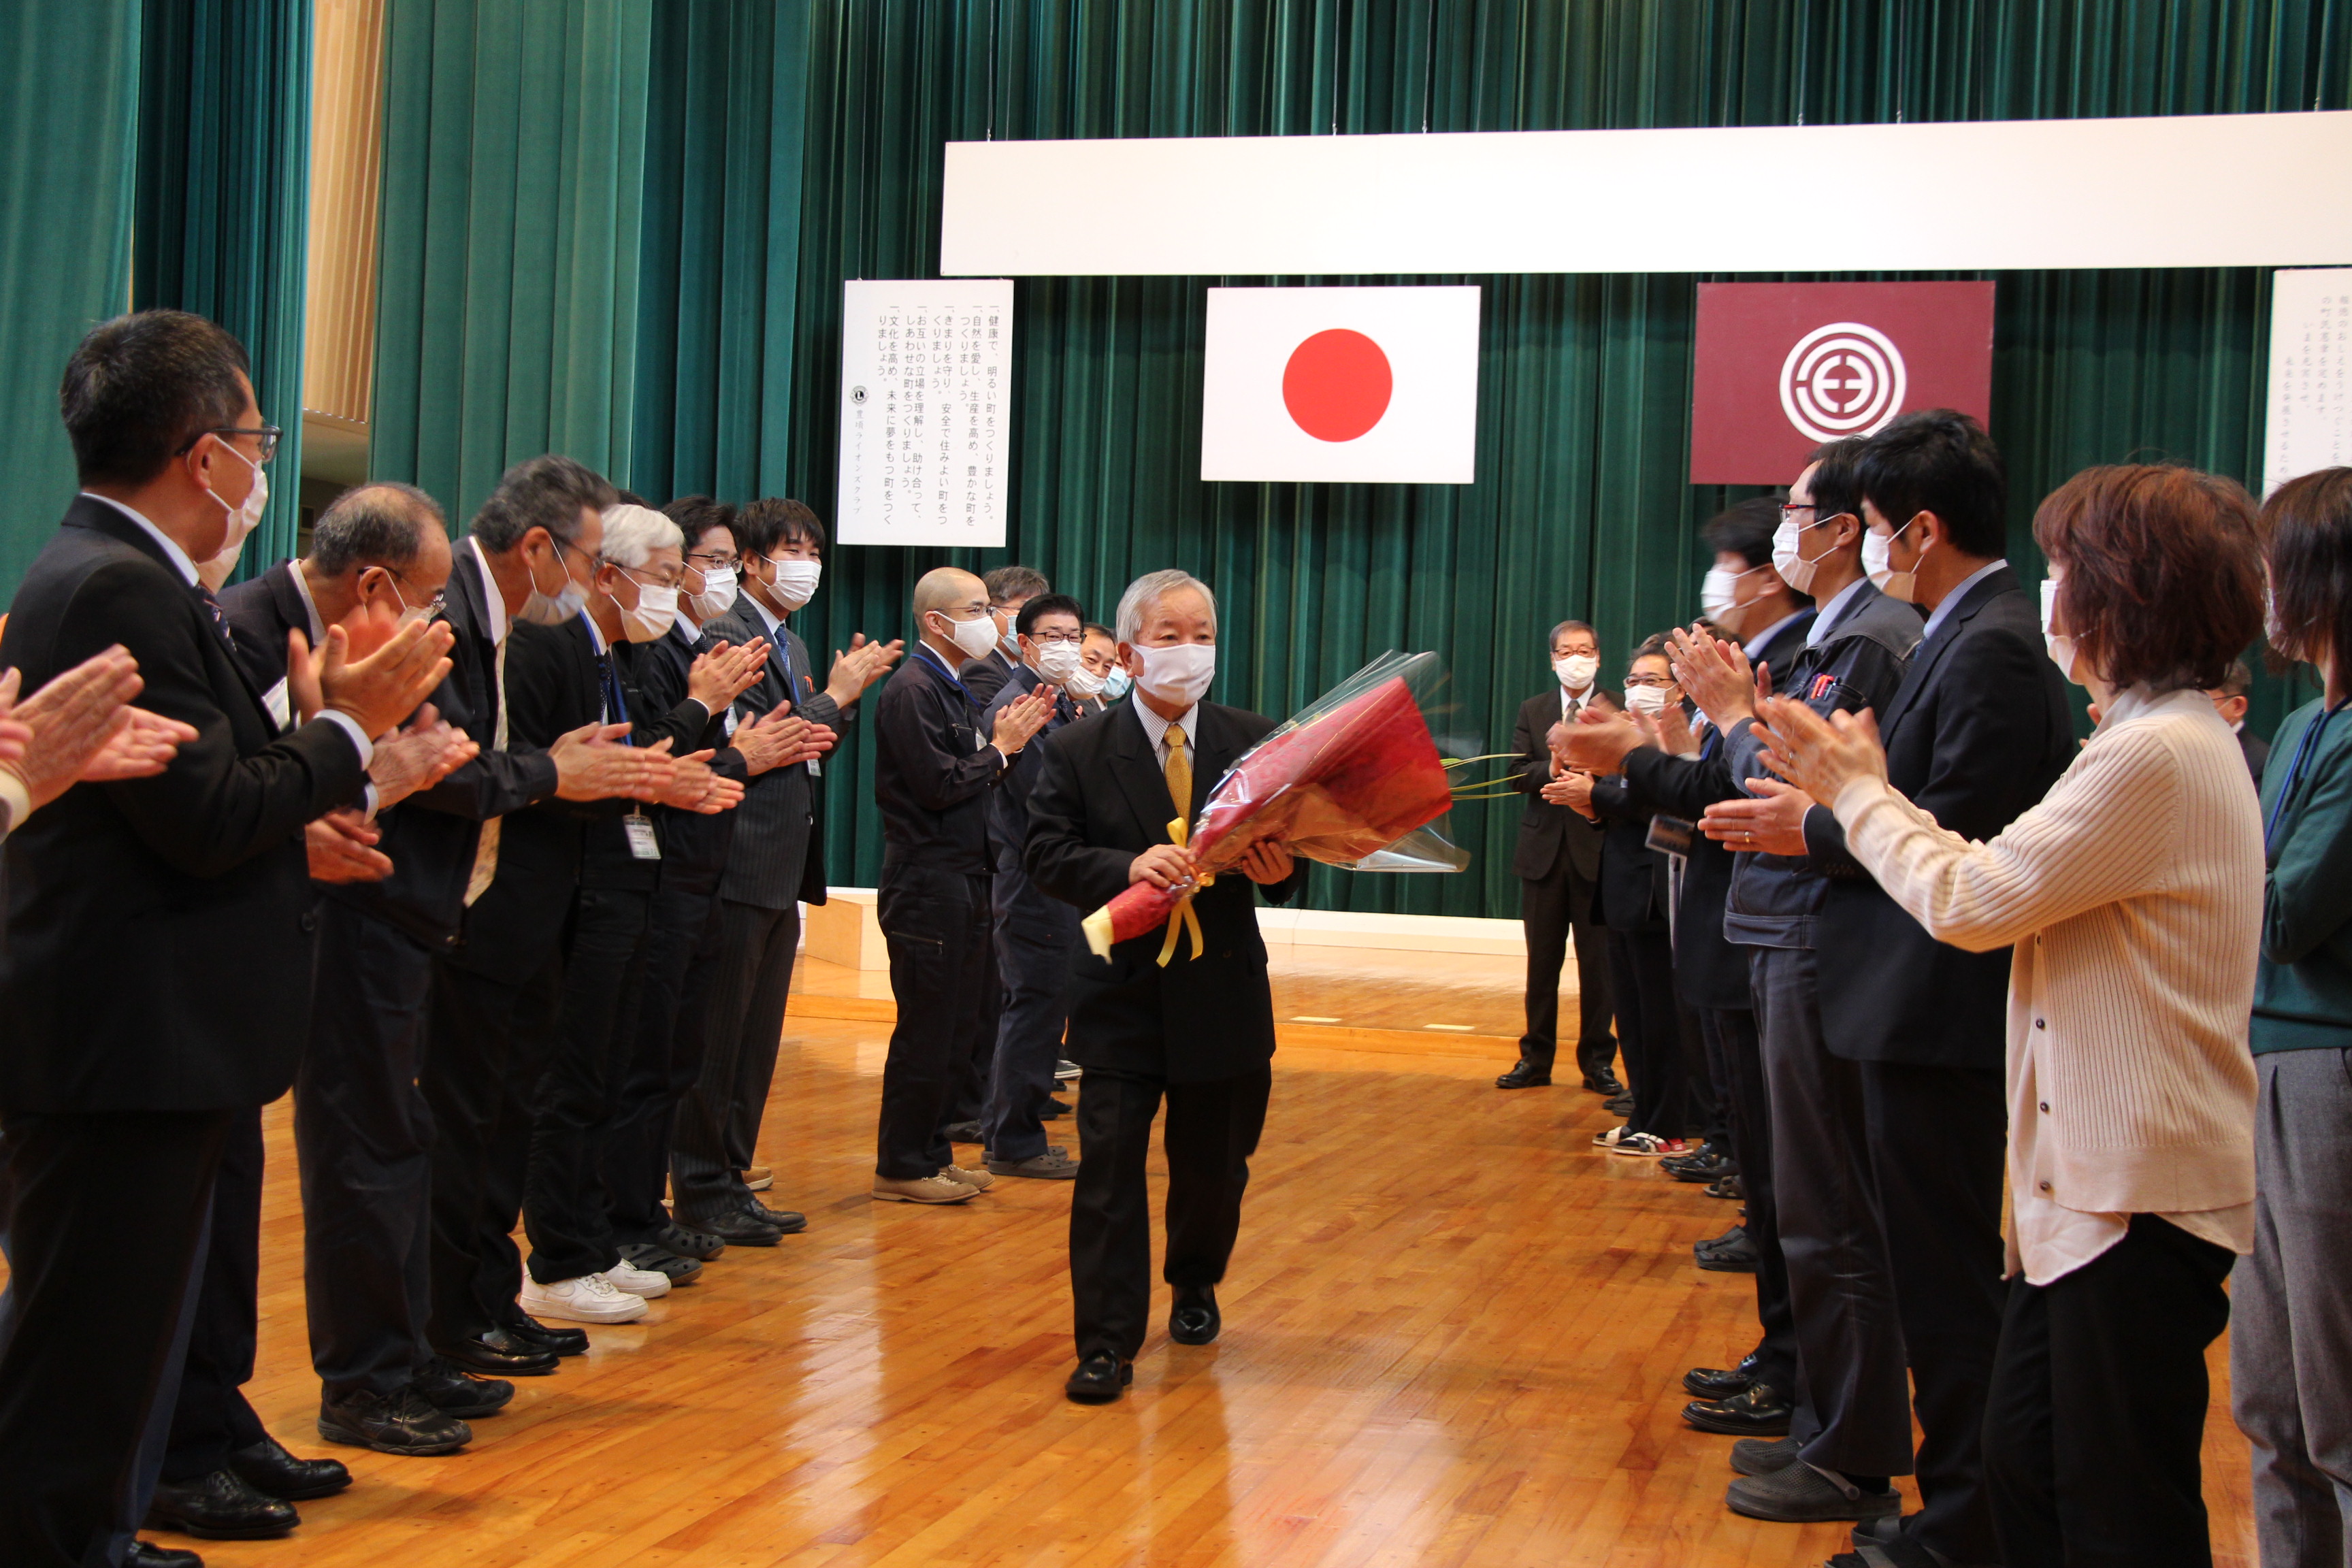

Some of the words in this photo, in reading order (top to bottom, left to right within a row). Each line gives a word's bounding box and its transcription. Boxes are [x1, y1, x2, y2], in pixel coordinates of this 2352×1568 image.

[877, 316, 887, 382] りましょう。
[883, 306, 900, 525] 一、文化を高め、未来に夢をもつ町をつく
[902, 316, 915, 495] しあわせな町をつくりましょう。
[911, 306, 928, 519] 一、お互いの立場を理解し、助け合って、
[932, 316, 942, 395] くりましょう。
[937, 306, 955, 525] 一、きまりを守り、安全で住みよい町をつ
[959, 316, 970, 408] つくりましょう。
[966, 306, 983, 527] 一、自然を愛し、生産を高め、豊かな町を
[984, 306, 999, 521] 一、健康で、明るい町をつくりましょう。
